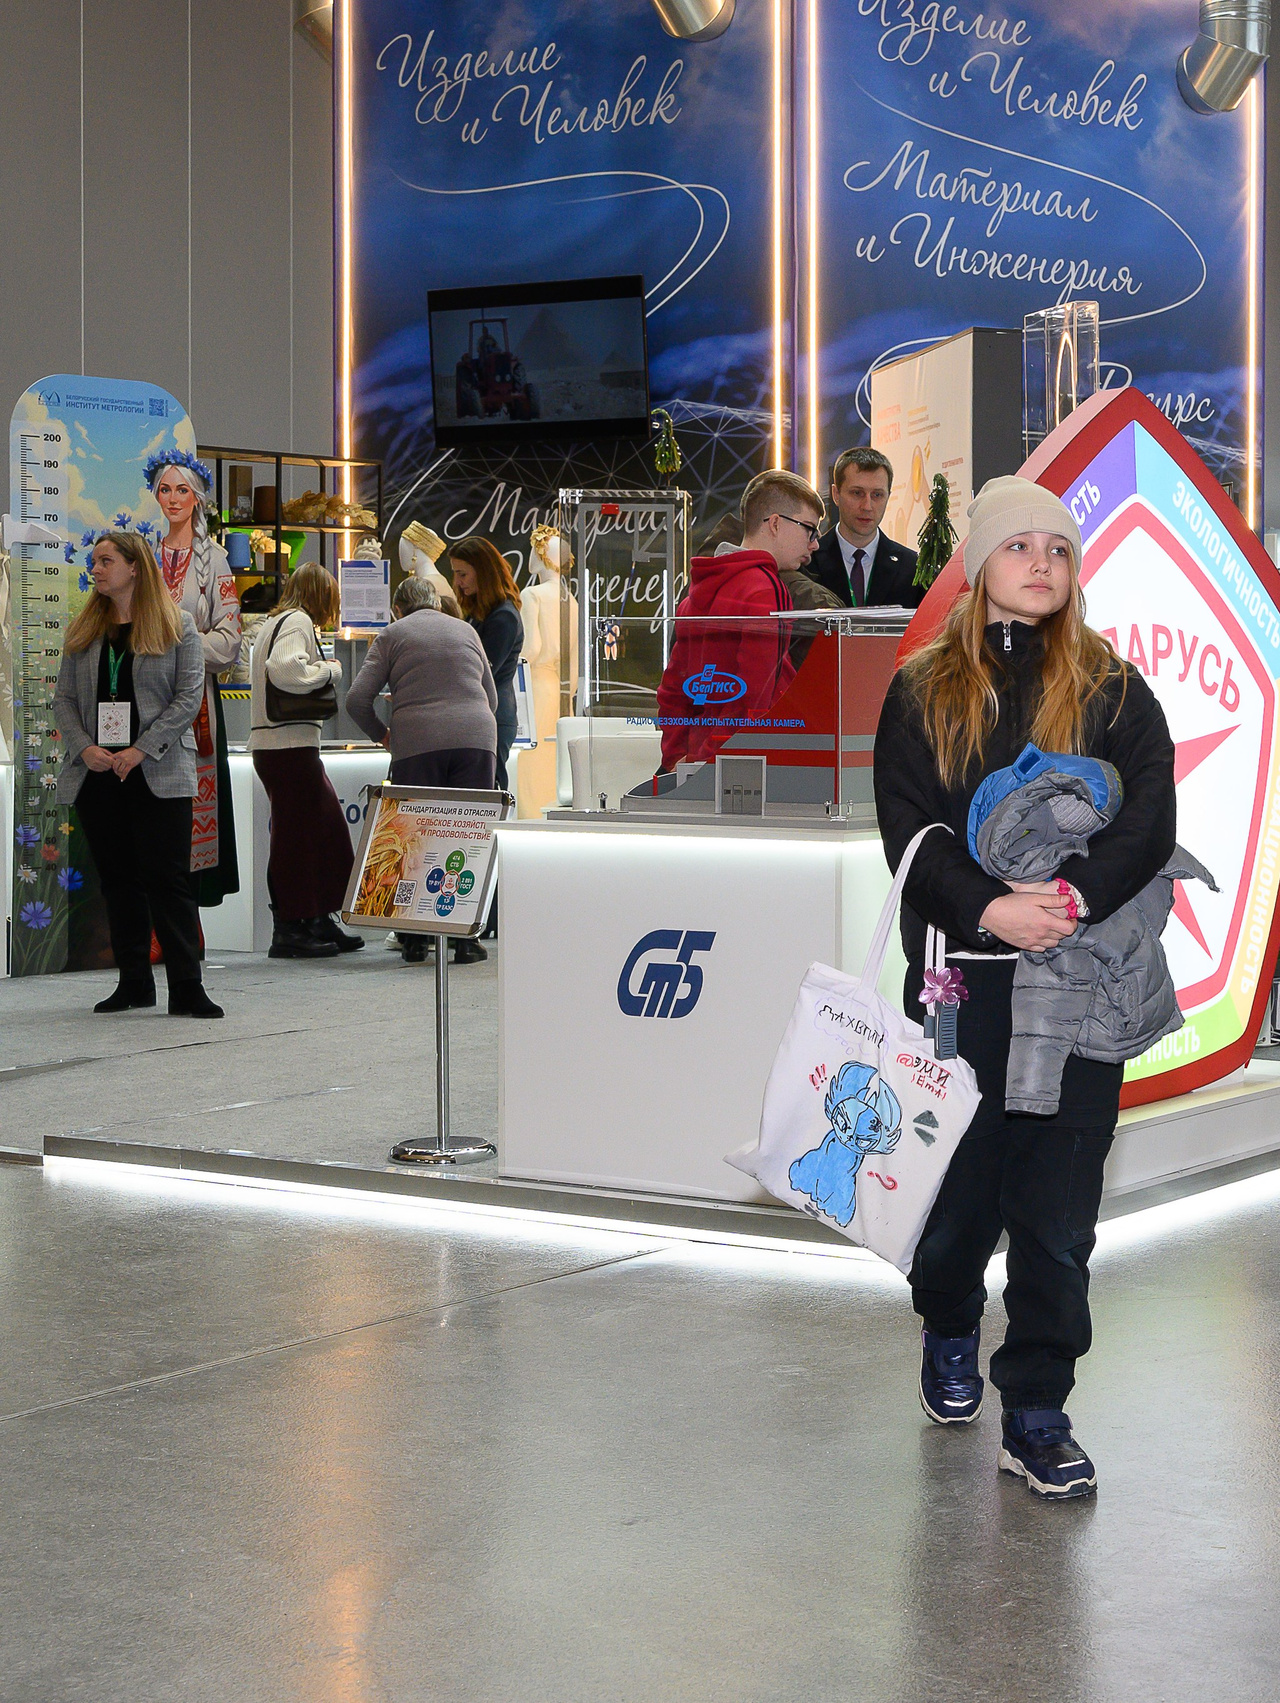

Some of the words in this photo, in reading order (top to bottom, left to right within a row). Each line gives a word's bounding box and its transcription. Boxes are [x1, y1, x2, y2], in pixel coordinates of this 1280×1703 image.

[376, 30, 562, 124] Изделие
[929, 70, 957, 98] и
[961, 51, 1147, 130] Человек
[461, 118, 488, 144] и
[492, 55, 684, 144] Человек
[843, 140, 1098, 238] Материал
[855, 234, 886, 263] и
[889, 212, 1143, 308] Инженерия
[43, 434, 61, 442] 200
[43, 460, 59, 469] 190
[44, 486, 59, 495] 180
[44, 513, 58, 522] 170
[1172, 481, 1280, 649] ЭКОЛОГИЧНОСТЬ
[44, 567, 59, 576] 150
[44, 594, 59, 603] 140
[45, 621, 59, 630] 130
[45, 648, 59, 657] 120
[45, 675, 57, 684] 110
[692, 682, 736, 694] БелГИСС
[702, 718, 772, 727] ИСПЫТАТЕЛЬНАЯ
[774, 719, 806, 728] КАМЕРА
[401, 805, 457, 815] СТАНДАРТИЗАЦИЯ
[416, 818, 451, 827] СЕЛЬСКОЕ
[452, 820, 486, 830] ХОЗЯЙСТ
[427, 830, 491, 841] ПРОДОВОЛЬСТВИЕ
